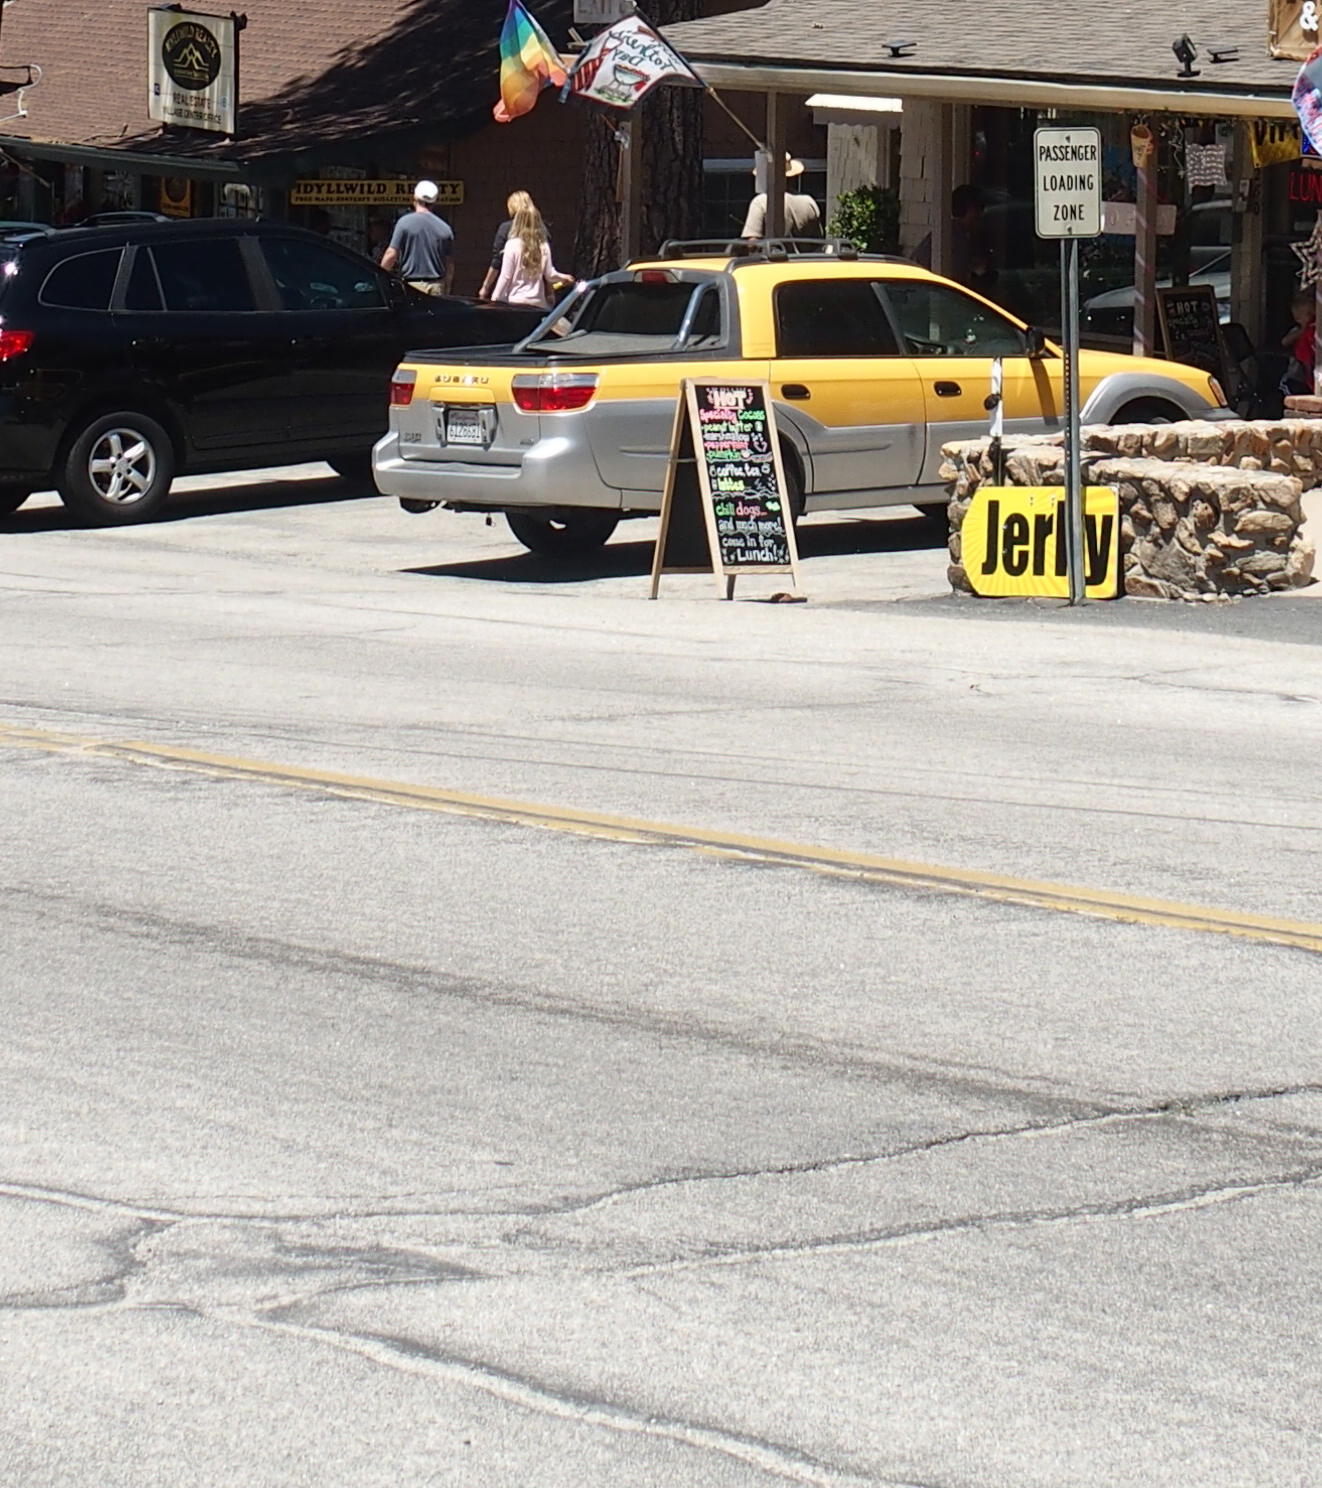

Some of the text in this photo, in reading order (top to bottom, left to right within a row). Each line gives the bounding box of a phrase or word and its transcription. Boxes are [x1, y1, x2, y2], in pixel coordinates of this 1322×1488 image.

[1299, 0, 1319, 32] &
[1039, 145, 1097, 161] PASSENGER
[295, 182, 461, 196] IDYLLWILD RETY
[1043, 174, 1094, 191] LOADING
[1053, 204, 1085, 221] ZONE
[1176, 300, 1199, 314] HOT
[713, 390, 747, 407] HOT
[718, 516, 783, 532] and much more!
[722, 534, 774, 548] come in for
[737, 544, 778, 562] Lunch!
